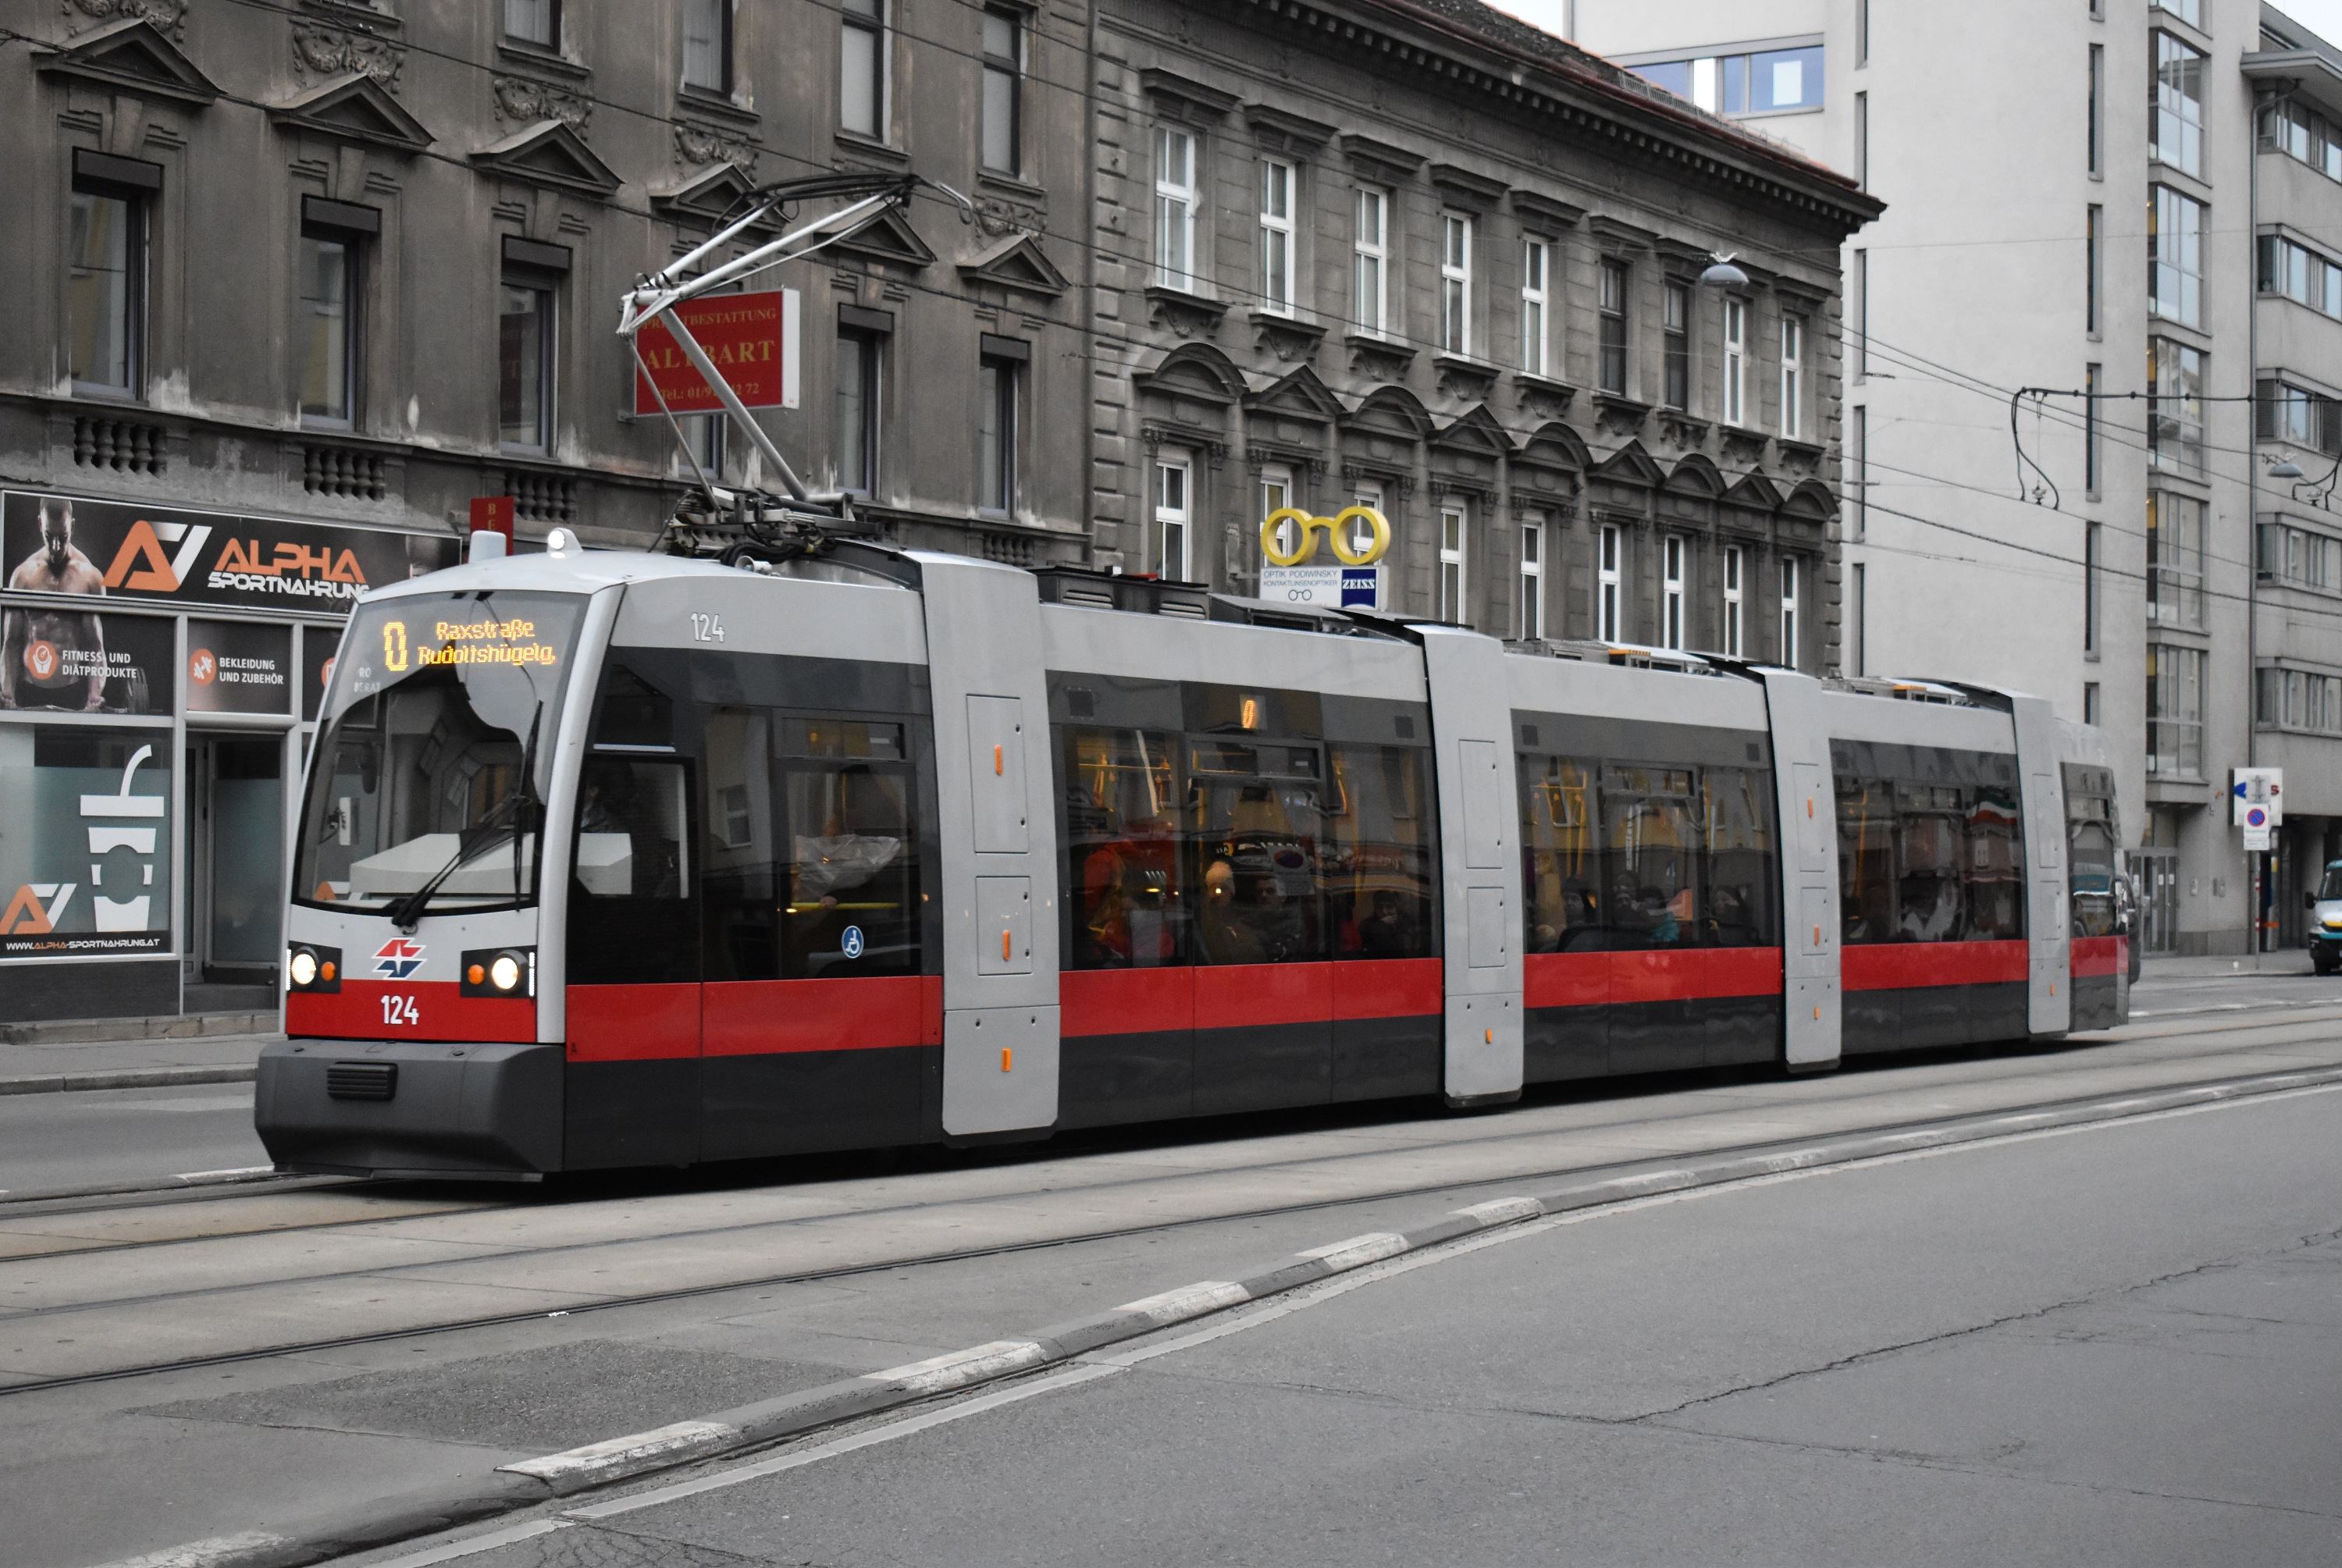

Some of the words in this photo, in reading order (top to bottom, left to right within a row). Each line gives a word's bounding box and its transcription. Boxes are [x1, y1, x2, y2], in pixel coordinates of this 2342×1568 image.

[644, 308, 776, 329] PRTBESTATTUNG
[214, 538, 366, 584] ALPHA
[1263, 570, 1287, 578] OPTIK
[1342, 578, 1375, 589] ZEISS
[436, 619, 536, 641] Raxstraße
[690, 613, 725, 642] 124
[109, 652, 131, 663] UND
[219, 657, 276, 670] BEKLEIDUNG
[62, 665, 137, 678] DIÄTPRODUKTE
[219, 673, 240, 683] UND
[242, 673, 284, 684] ZUBEHÖR
[380, 994, 419, 1026] 124
